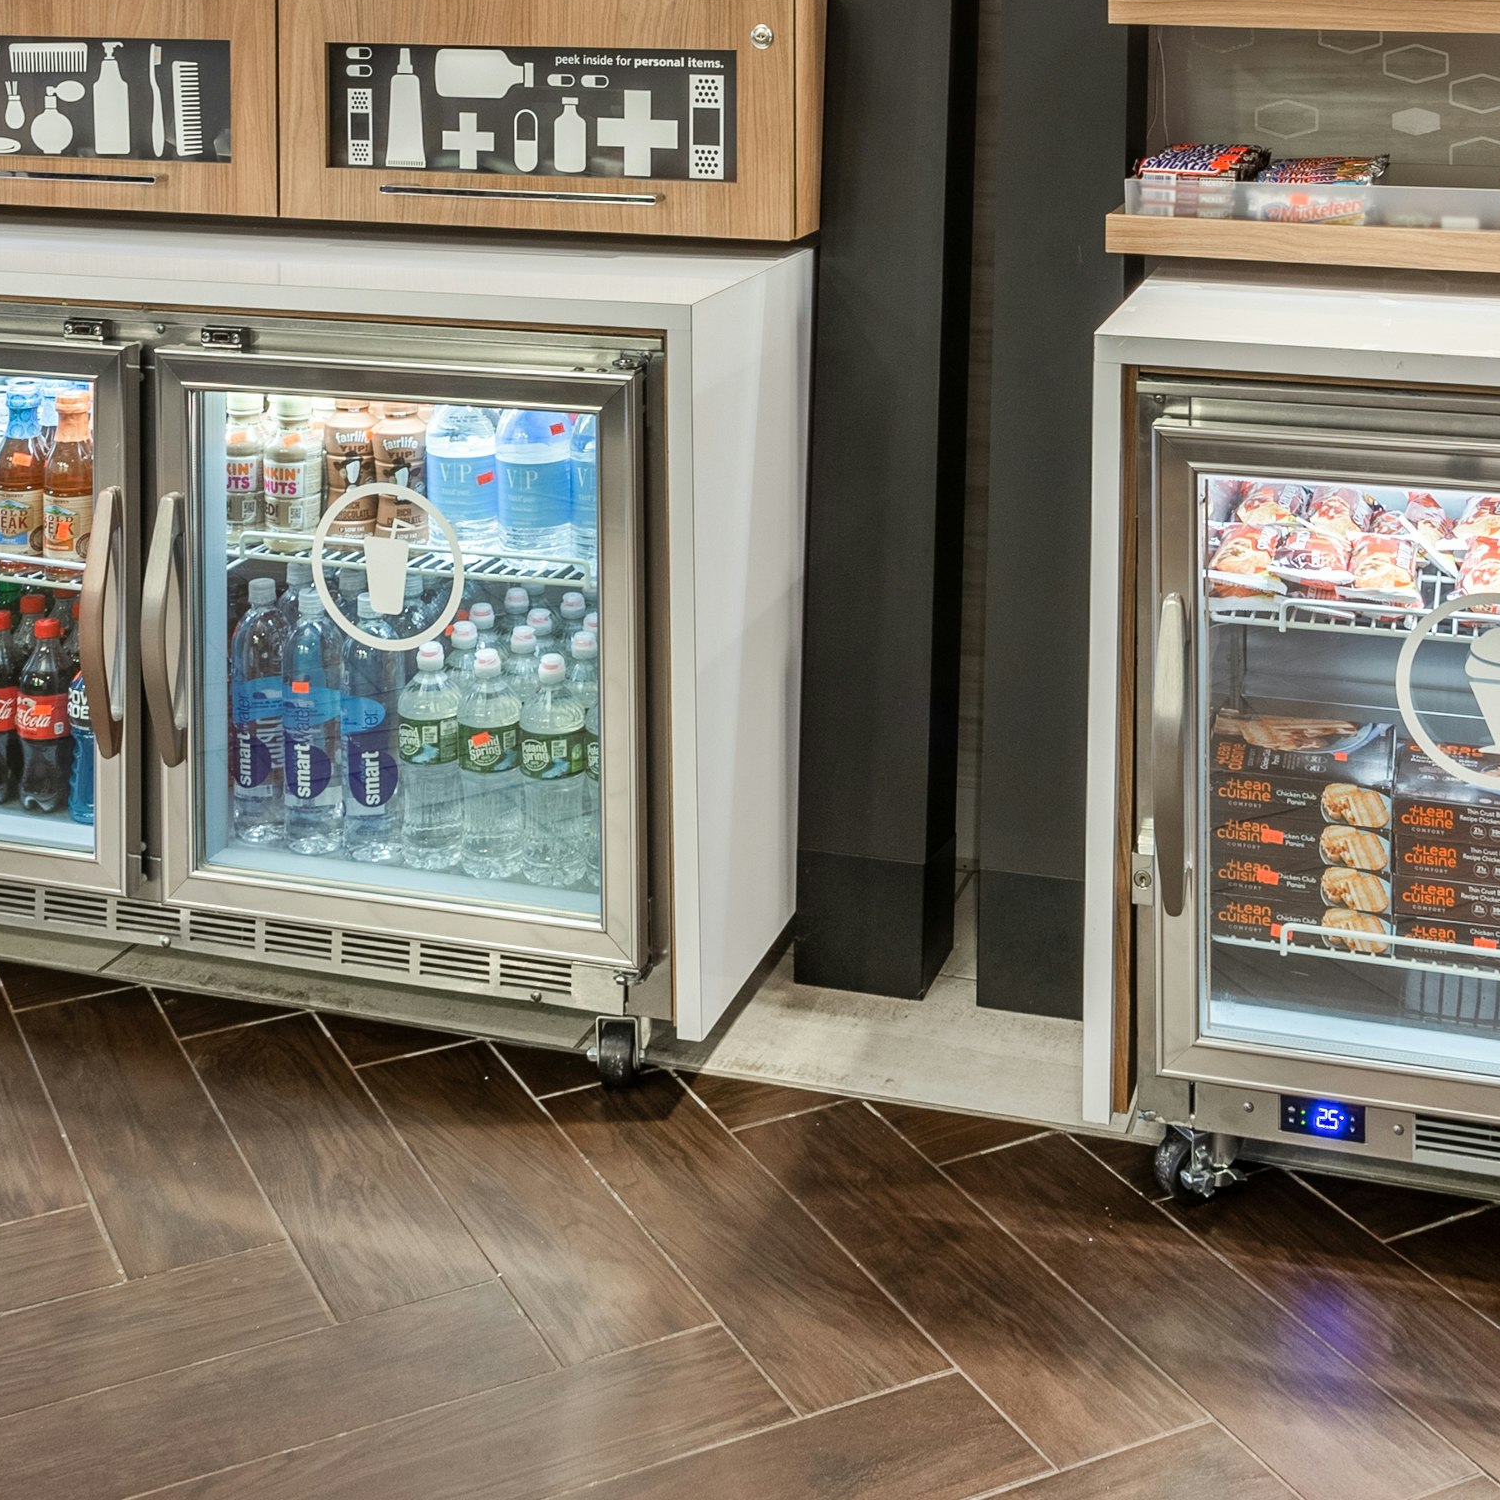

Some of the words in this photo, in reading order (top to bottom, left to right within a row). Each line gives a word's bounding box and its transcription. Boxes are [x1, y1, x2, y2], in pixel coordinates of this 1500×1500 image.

[555, 55, 581, 67] peek
[583, 55, 614, 67] inside
[615, 56, 632, 67] for
[633, 57, 685, 70] personal
[687, 58, 725, 70] items.
[339, 445, 368, 453] YUP!
[388, 450, 417, 459] YUP!
[468, 744, 500, 762] Spring
[520, 741, 547, 756] Poland
[520, 750, 550, 767] Spring
[1276, 788, 1302, 799] Chicken
[1302, 791, 1318, 801] Club
[1286, 798, 1307, 806] Panini
[1467, 808, 1479, 816] Thin
[1479, 810, 1496, 819] Crust
[1459, 815, 1478, 824] Recipe
[1478, 817, 1500, 827] Chicken
[1301, 834, 1316, 843] Club
[1285, 840, 1305, 849] Panini
[1462, 853, 1481, 863] Recipe
[1470, 847, 1482, 855] Thin
[1482, 849, 1498, 858] Crust
[1302, 875, 1317, 884] Club
[1286, 881, 1306, 890] Panini
[1468, 886, 1480, 894] Thin
[1480, 888, 1496, 897] Crust
[1460, 893, 1479, 902] Recipe
[1276, 913, 1302, 923] Chicken
[1302, 916, 1318, 925] Club
[1470, 928, 1494, 938] Chicken
[1315, 1107, 1339, 1131] 25
